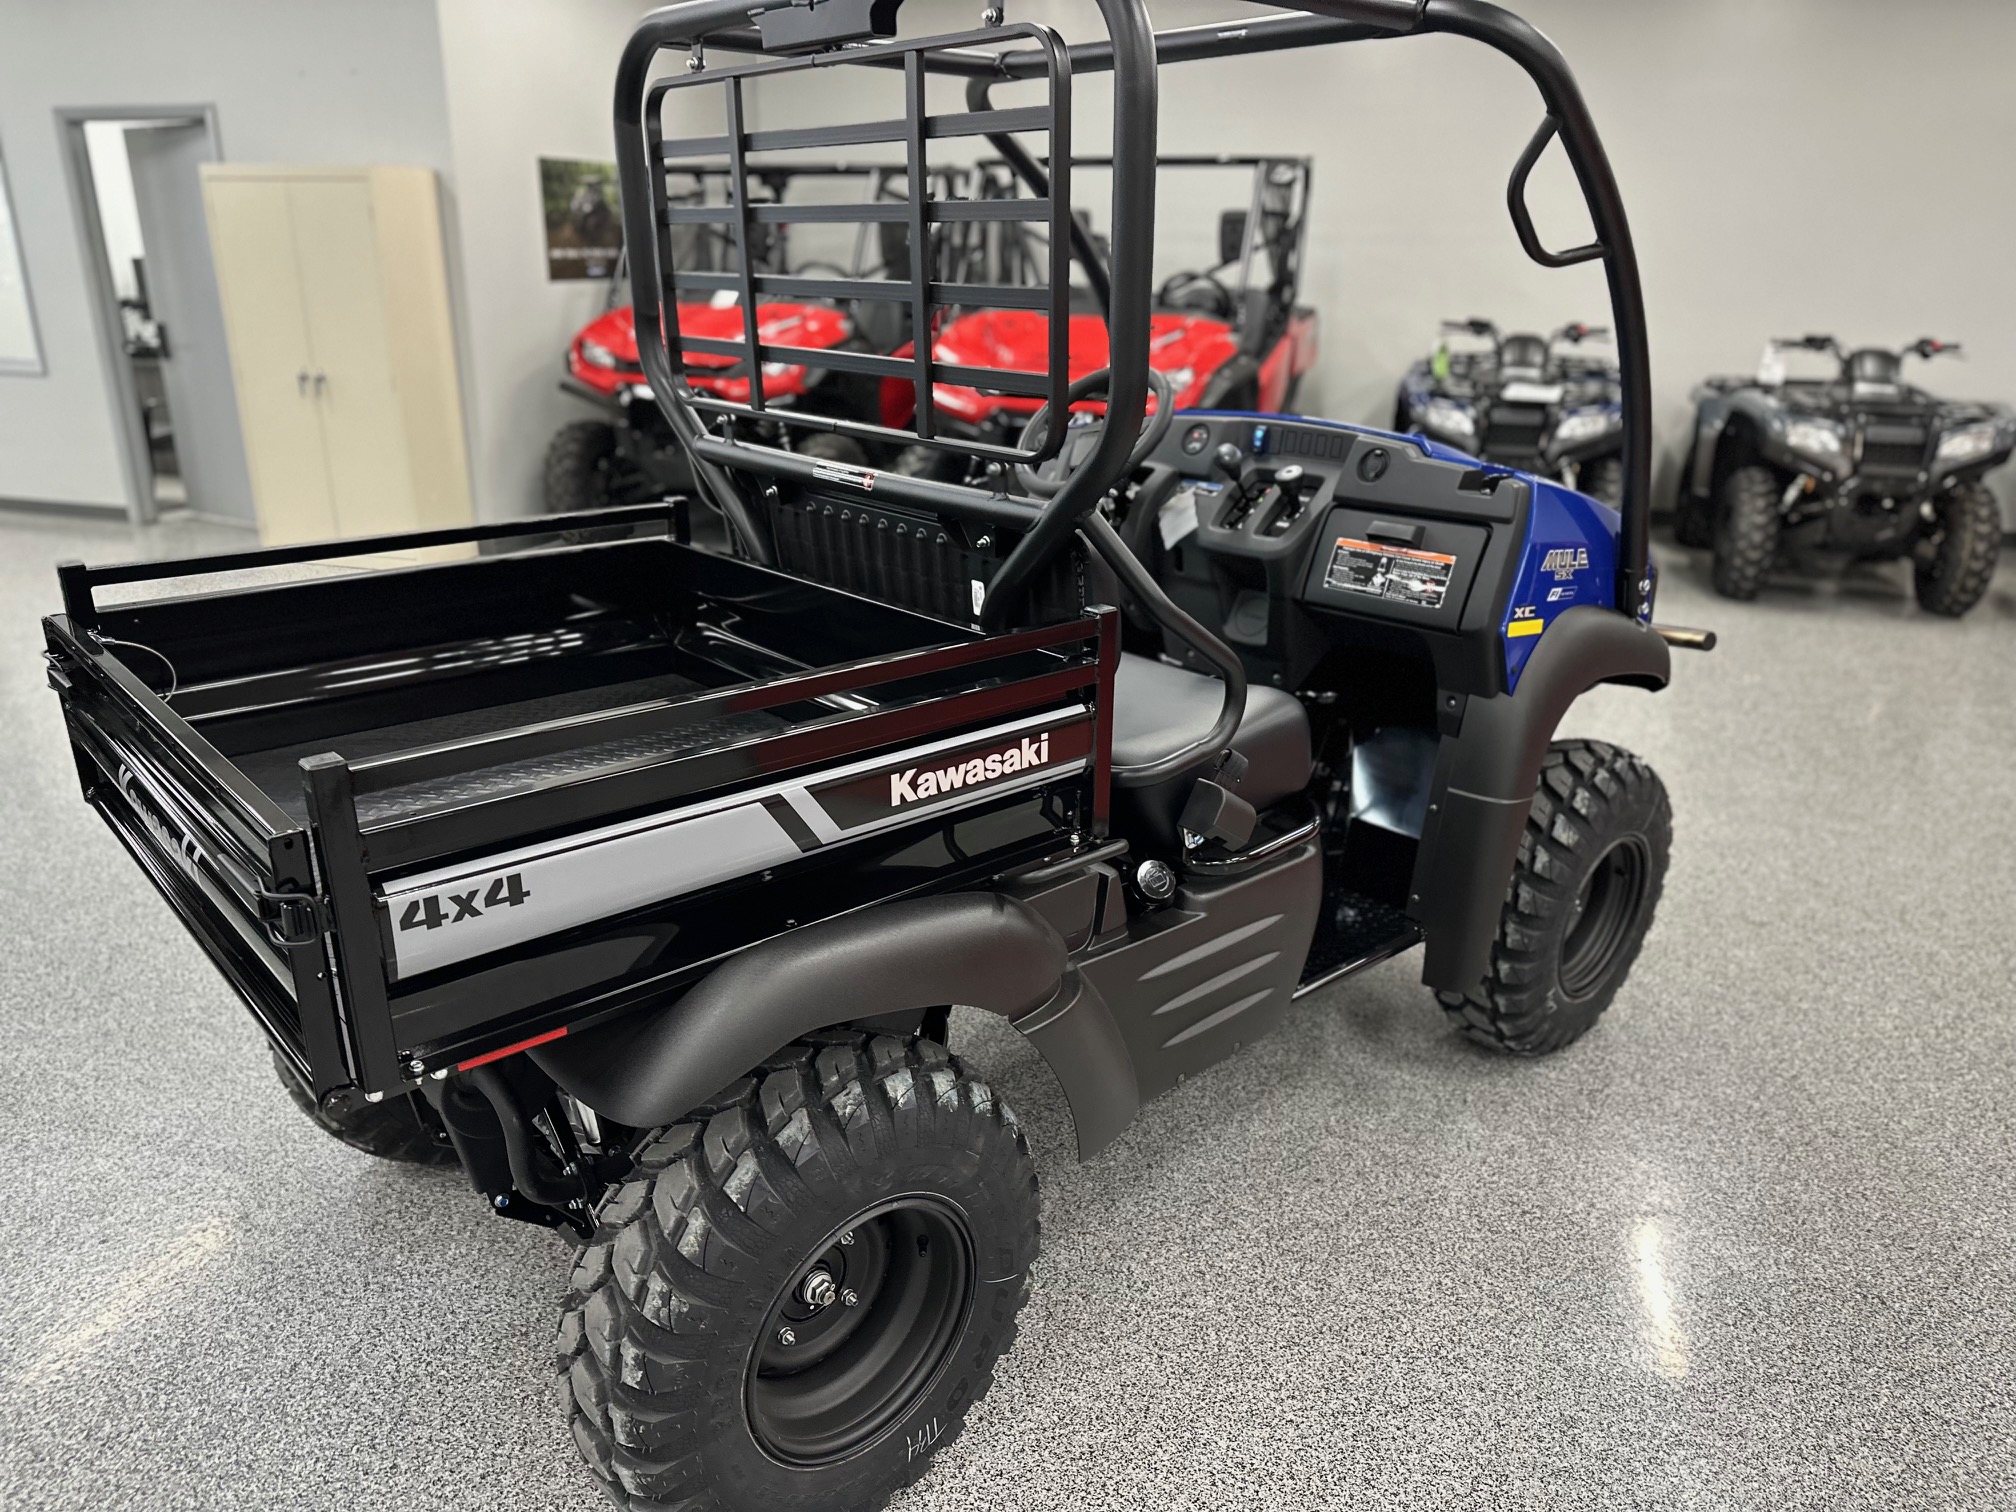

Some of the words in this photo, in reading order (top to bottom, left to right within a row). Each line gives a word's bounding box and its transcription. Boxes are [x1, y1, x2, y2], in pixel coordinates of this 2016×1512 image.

[1541, 548, 1589, 571] MULE
[1554, 570, 1573, 581] SX
[1514, 606, 1536, 619] XC
[890, 732, 1049, 807] Kawasaki
[399, 873, 531, 931] 4x4
